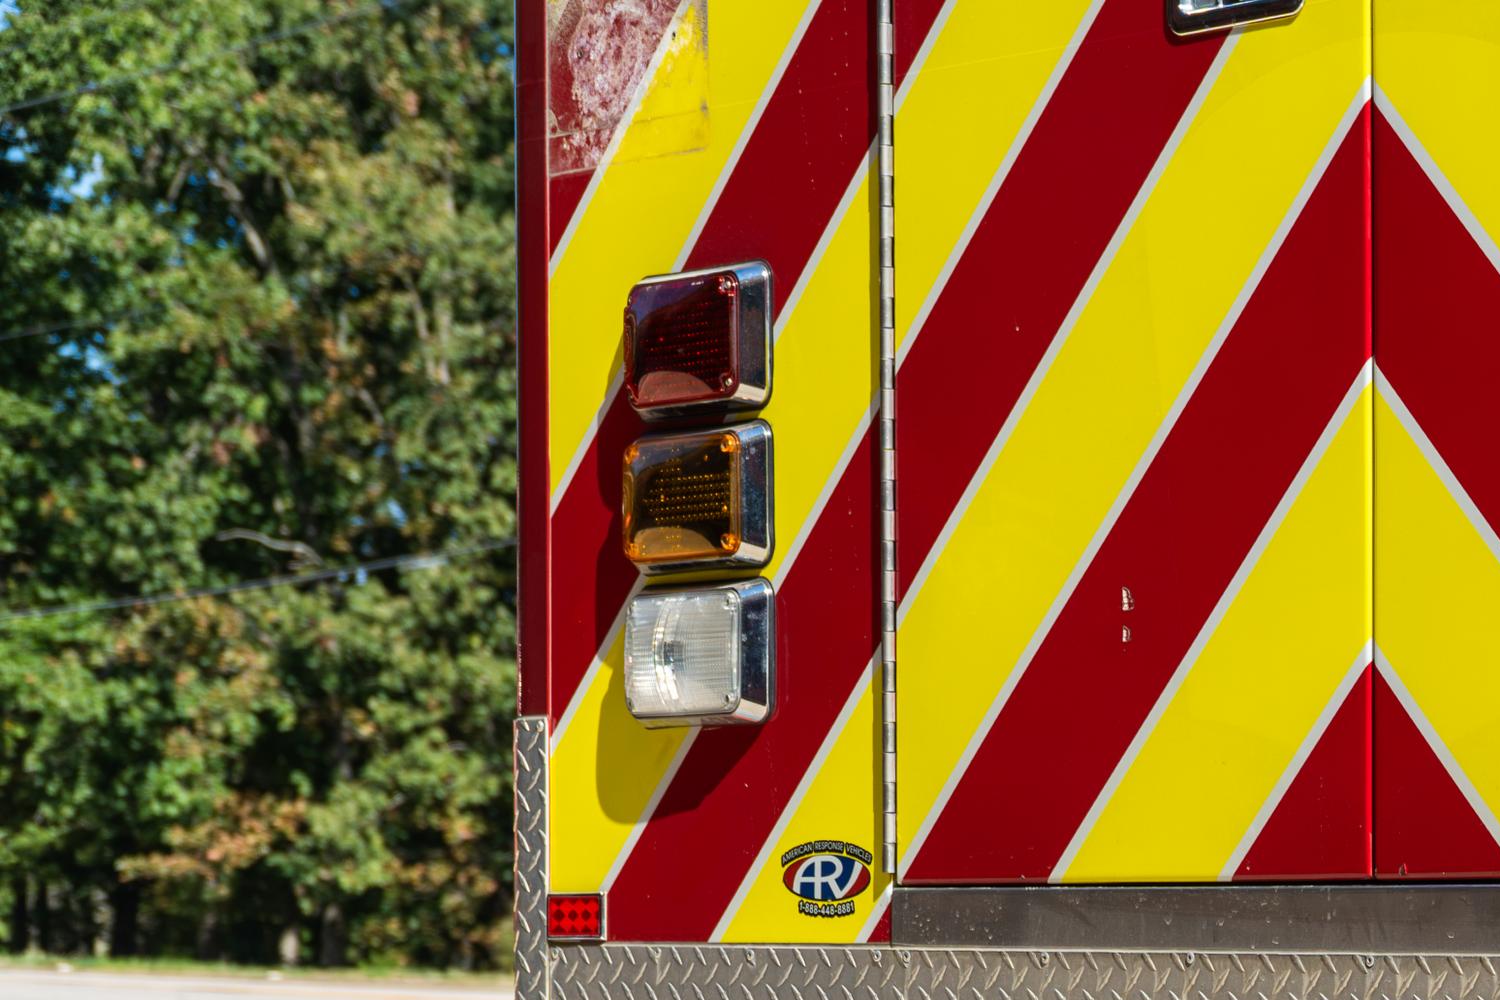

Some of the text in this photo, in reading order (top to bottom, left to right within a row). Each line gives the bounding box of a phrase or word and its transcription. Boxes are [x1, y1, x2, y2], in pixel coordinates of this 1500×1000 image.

[782, 842, 872, 864] AMERICAN RESPONSE VEHICLES
[792, 855, 863, 900] ARV
